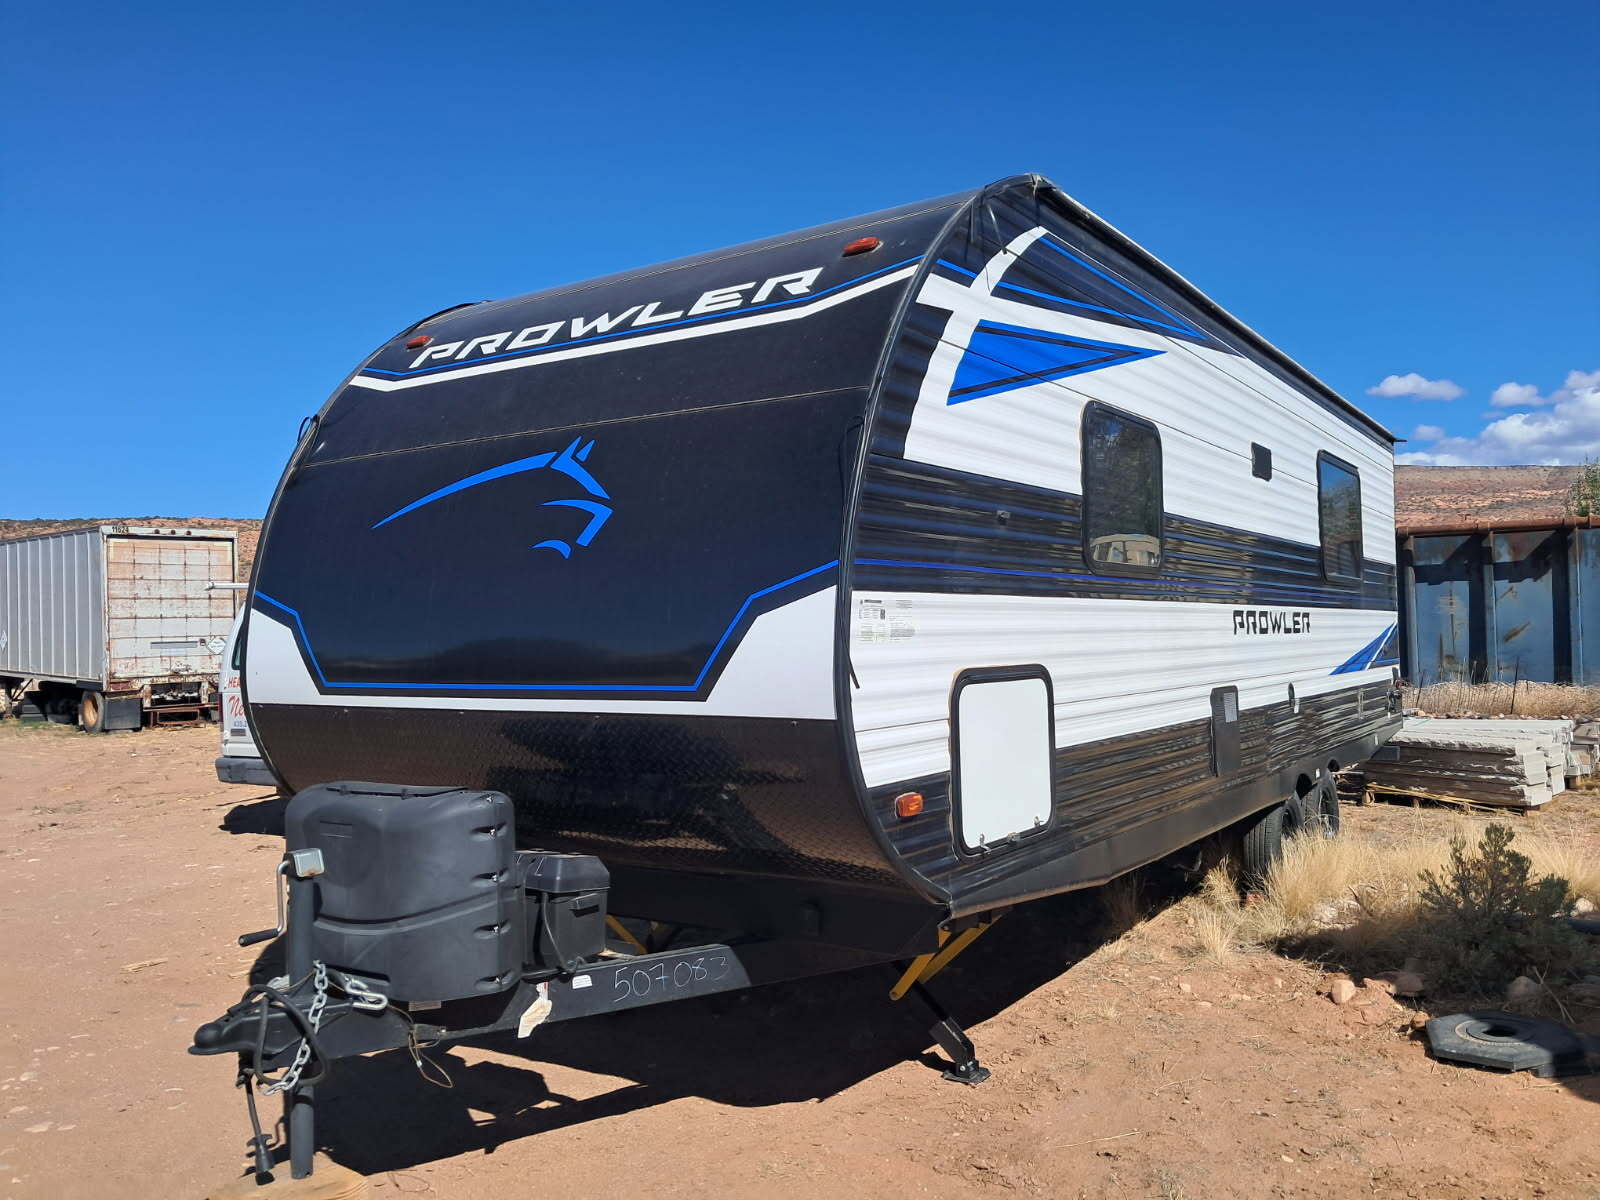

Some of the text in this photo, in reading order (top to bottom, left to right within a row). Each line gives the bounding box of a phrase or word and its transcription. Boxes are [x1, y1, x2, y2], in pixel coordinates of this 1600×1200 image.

[408, 266, 824, 369] PROWLER
[1232, 609, 1311, 636] PROWLER
[613, 956, 730, 1003] 507083
